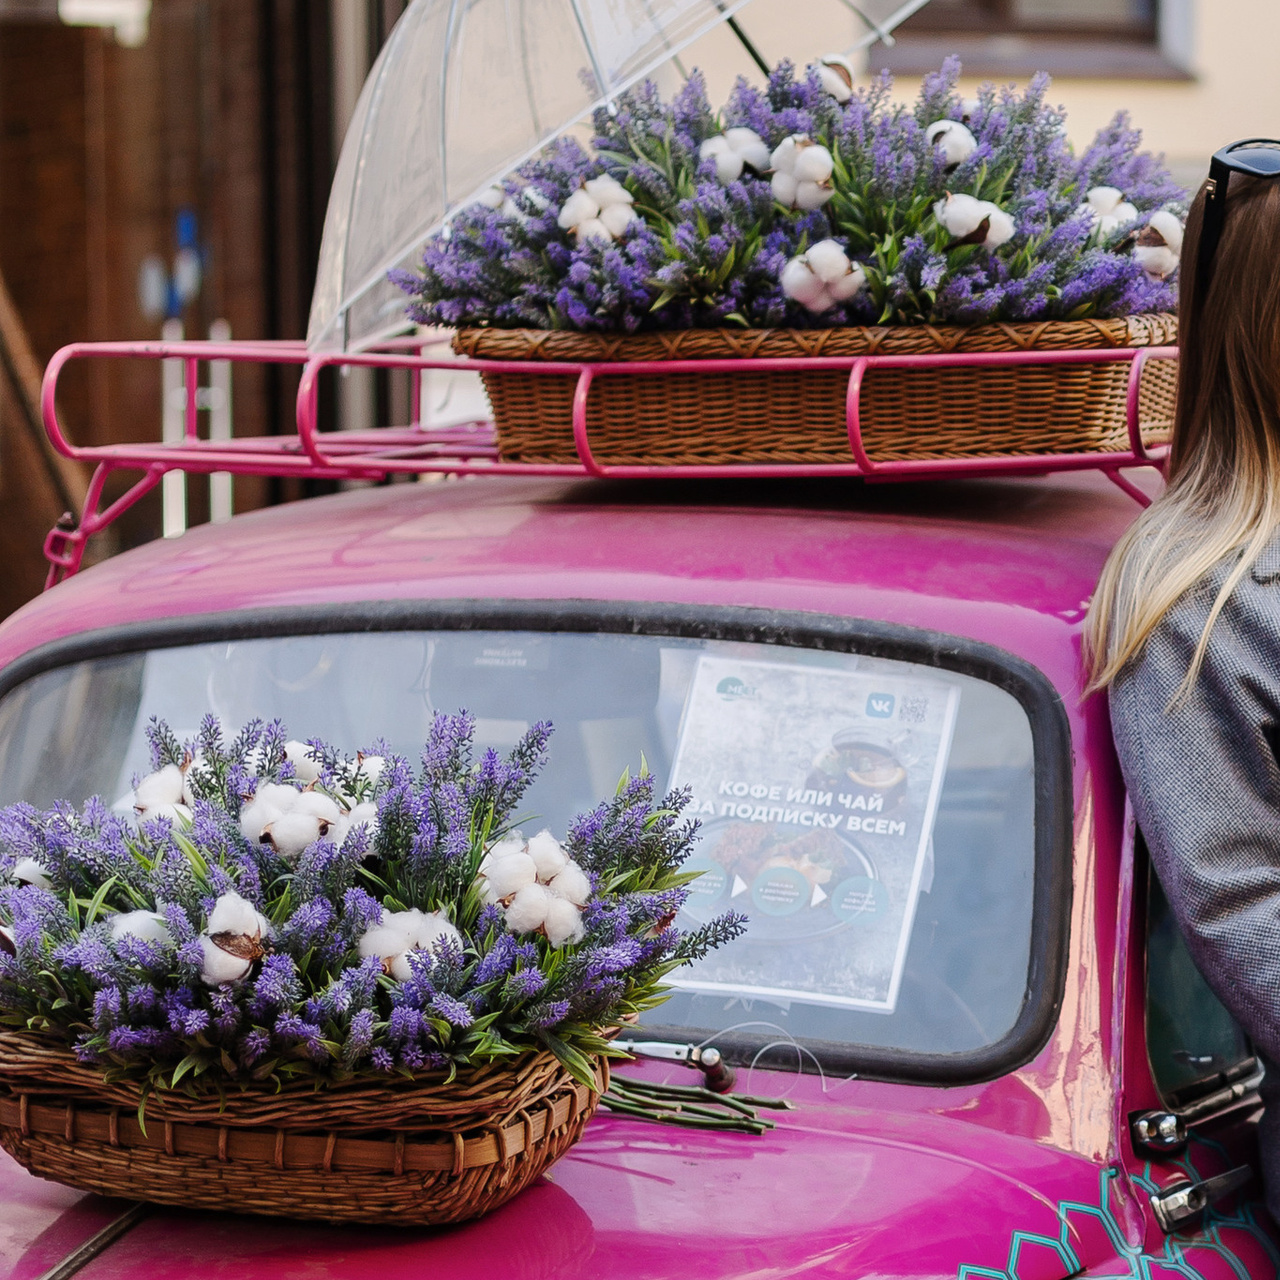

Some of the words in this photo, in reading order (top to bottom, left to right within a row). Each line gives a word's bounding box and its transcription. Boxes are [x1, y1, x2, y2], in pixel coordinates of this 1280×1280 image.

[718, 780, 782, 801] КОФЕ
[786, 787, 834, 807] ИЛИ
[838, 793, 884, 813] ЧАЙ
[689, 799, 716, 815] ЗА
[720, 801, 844, 829] ПОДПИСКУ
[846, 815, 907, 837] ВСЕМ
